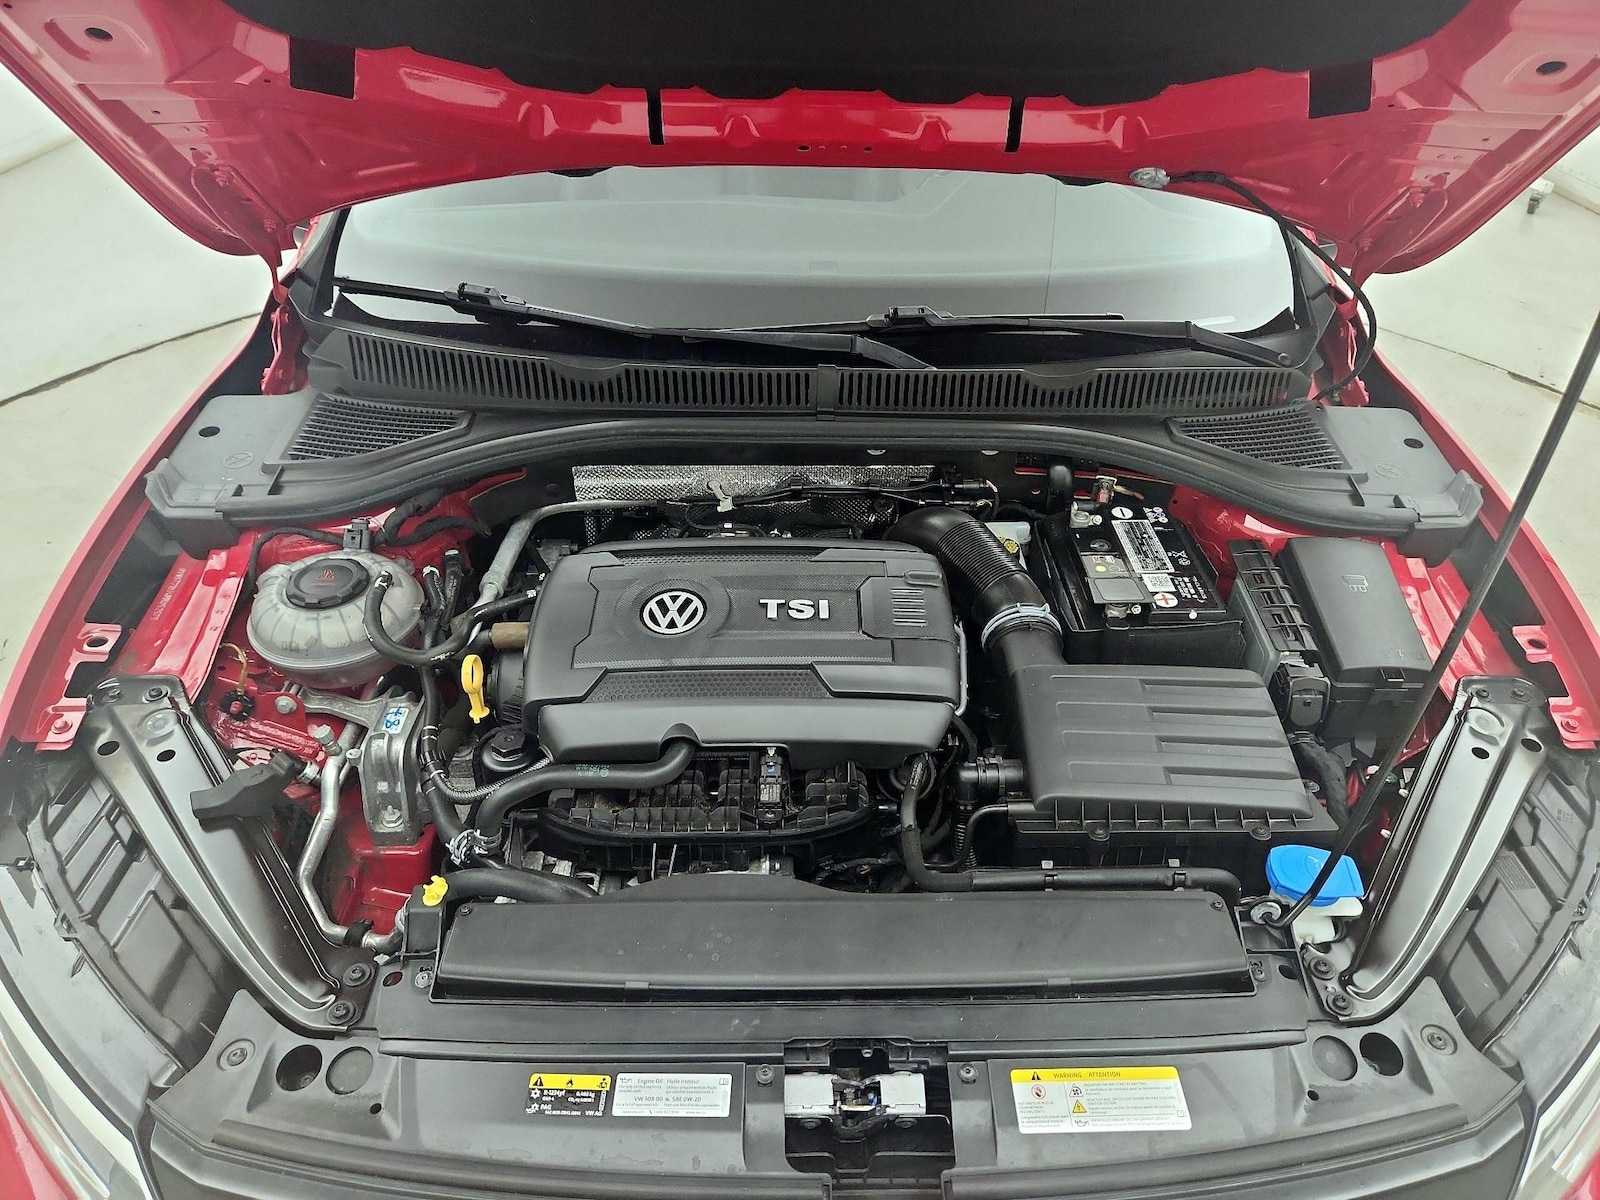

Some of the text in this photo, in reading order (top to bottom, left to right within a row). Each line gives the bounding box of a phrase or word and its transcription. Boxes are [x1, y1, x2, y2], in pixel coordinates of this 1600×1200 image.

[642, 590, 704, 635] VW
[759, 599, 830, 620] TSI
[637, 1078, 655, 1086] Engine
